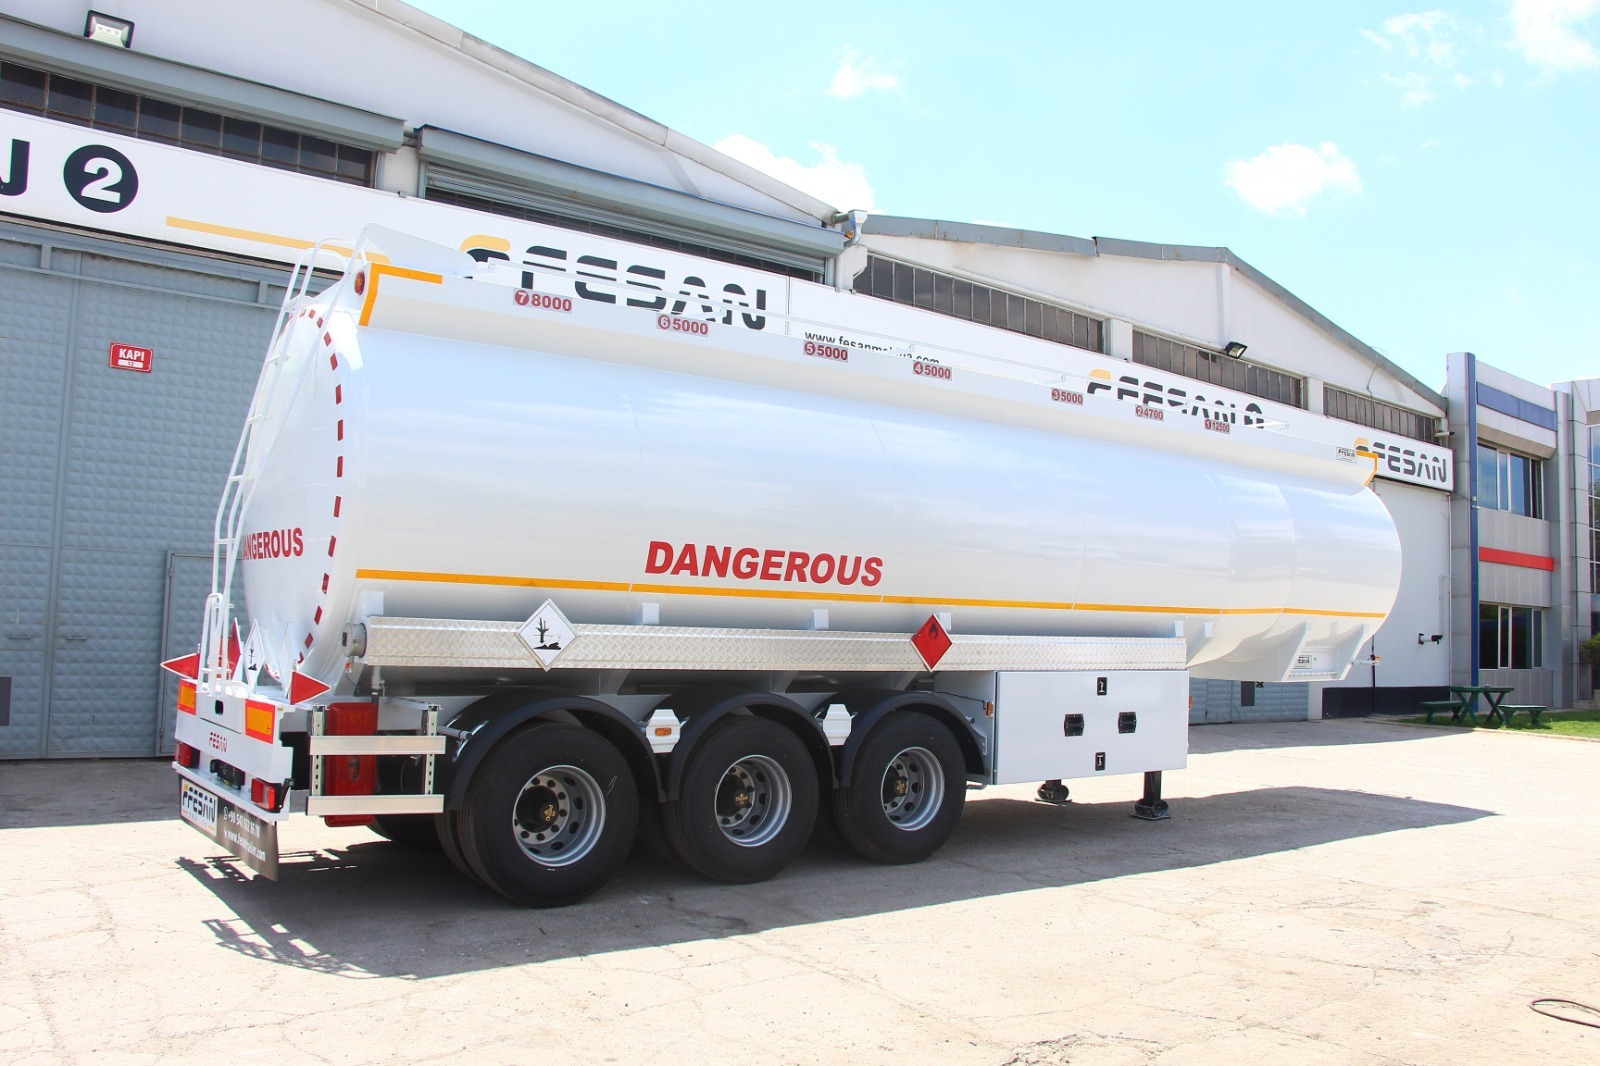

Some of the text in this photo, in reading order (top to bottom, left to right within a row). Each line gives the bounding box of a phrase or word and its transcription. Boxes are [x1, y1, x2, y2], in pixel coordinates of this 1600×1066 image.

[81, 155, 123, 205] 2
[531, 293, 573, 312] 8000
[672, 319, 709, 335] 5000
[119, 348, 145, 362] KAPI
[817, 344, 849, 361] 5000
[924, 365, 951, 379] 5000
[1061, 391, 1084, 405] 5000
[1144, 407, 1164, 421] 4700
[1212, 421, 1230, 433] 12500
[645, 541, 883, 587] DANGEROUS
[209, 731, 228, 752] FESAN
